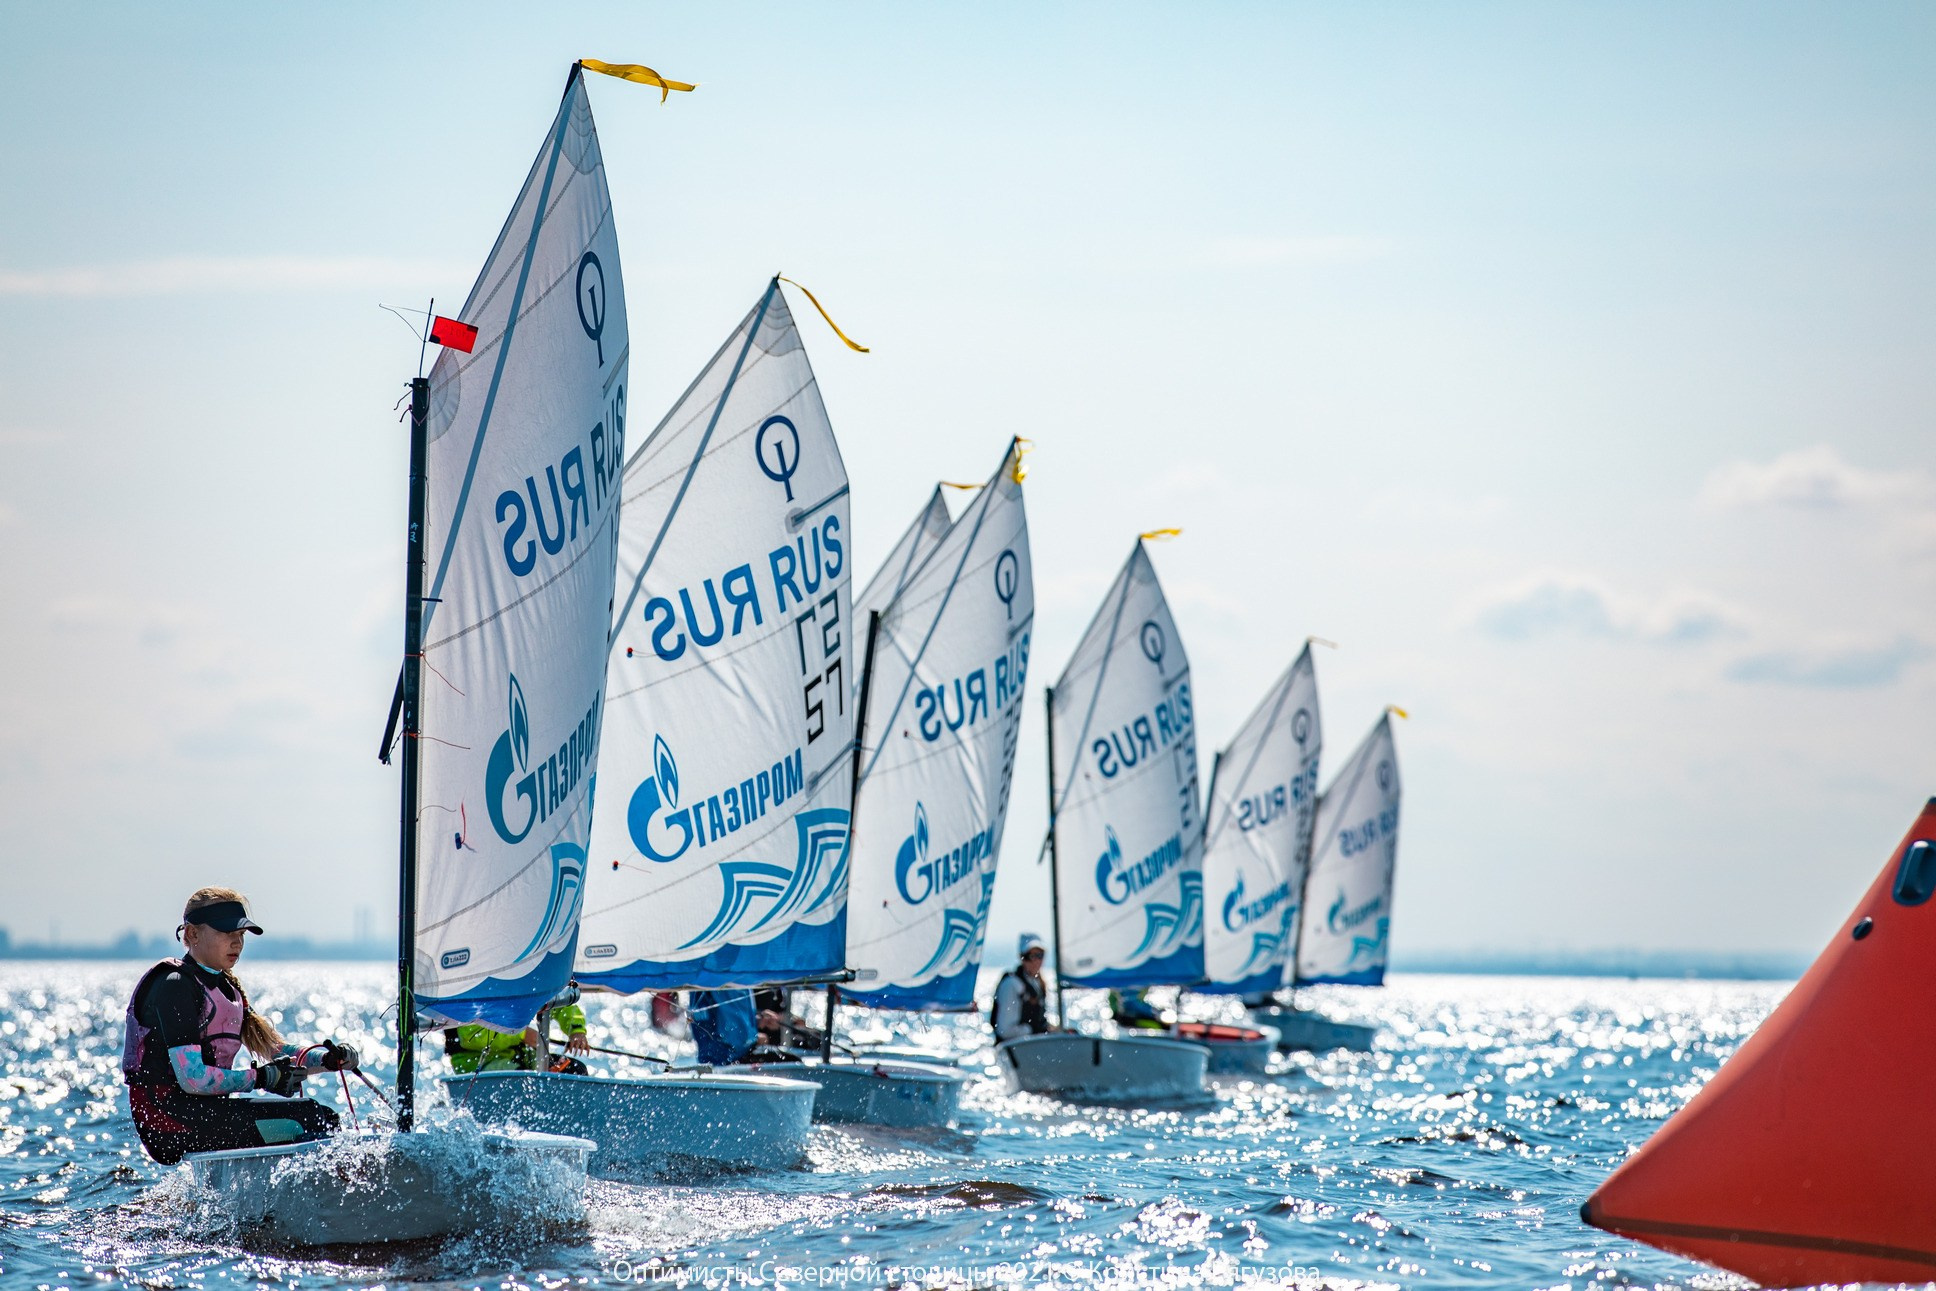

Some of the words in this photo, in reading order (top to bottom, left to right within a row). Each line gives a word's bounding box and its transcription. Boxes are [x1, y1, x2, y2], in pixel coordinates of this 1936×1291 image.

[590, 384, 624, 512] RUS
[769, 514, 843, 614] RUS
[690, 747, 804, 849] ГАЗПРОМ
